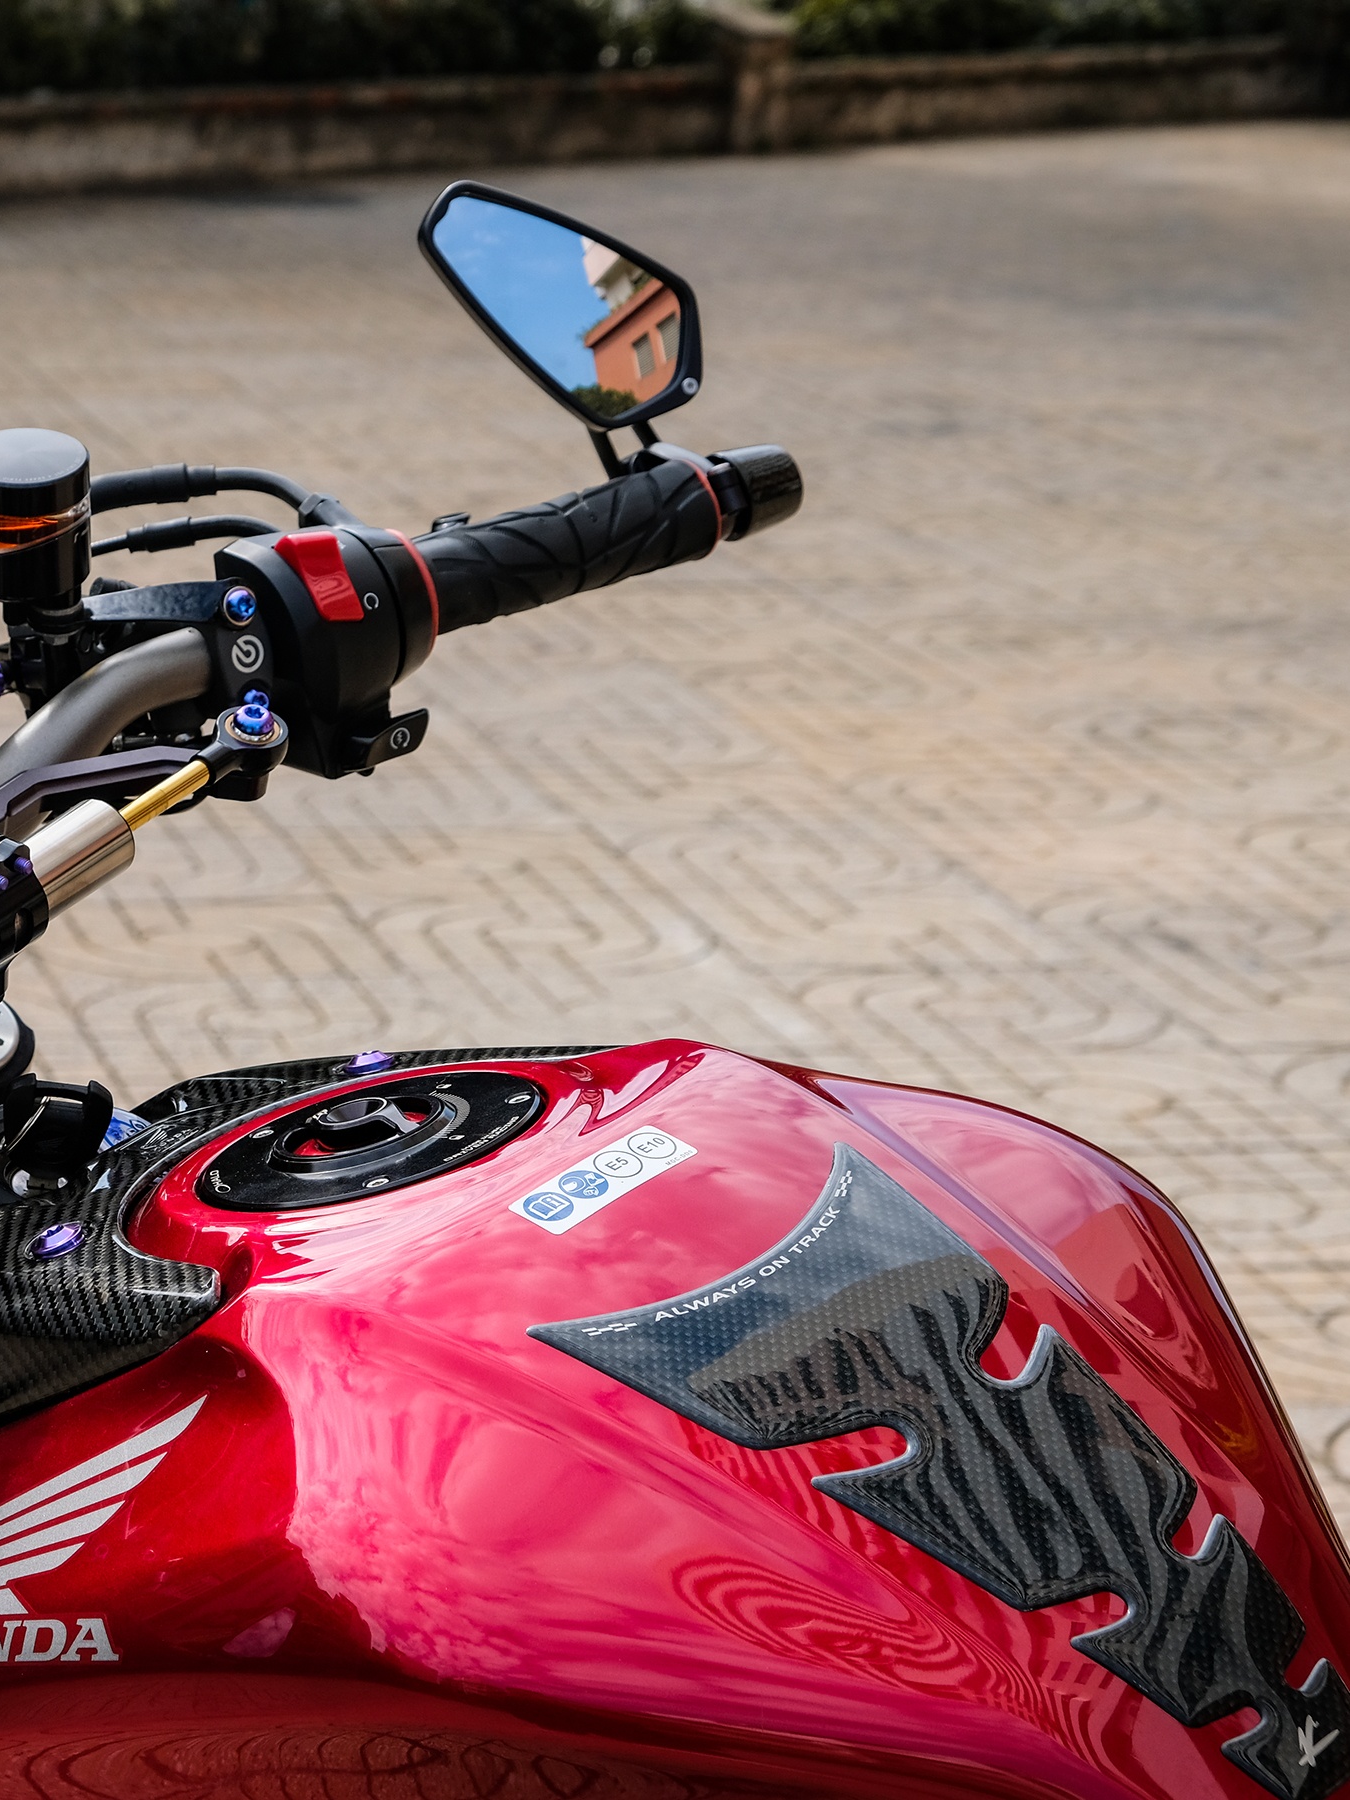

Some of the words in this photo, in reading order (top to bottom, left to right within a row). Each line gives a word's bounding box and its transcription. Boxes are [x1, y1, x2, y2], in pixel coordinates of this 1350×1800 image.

[637, 1136, 666, 1154] E10
[605, 1156, 629, 1172] E5
[654, 1275, 757, 1322] ALWAYS
[758, 1255, 791, 1278] ON
[788, 1205, 841, 1255] TRACK
